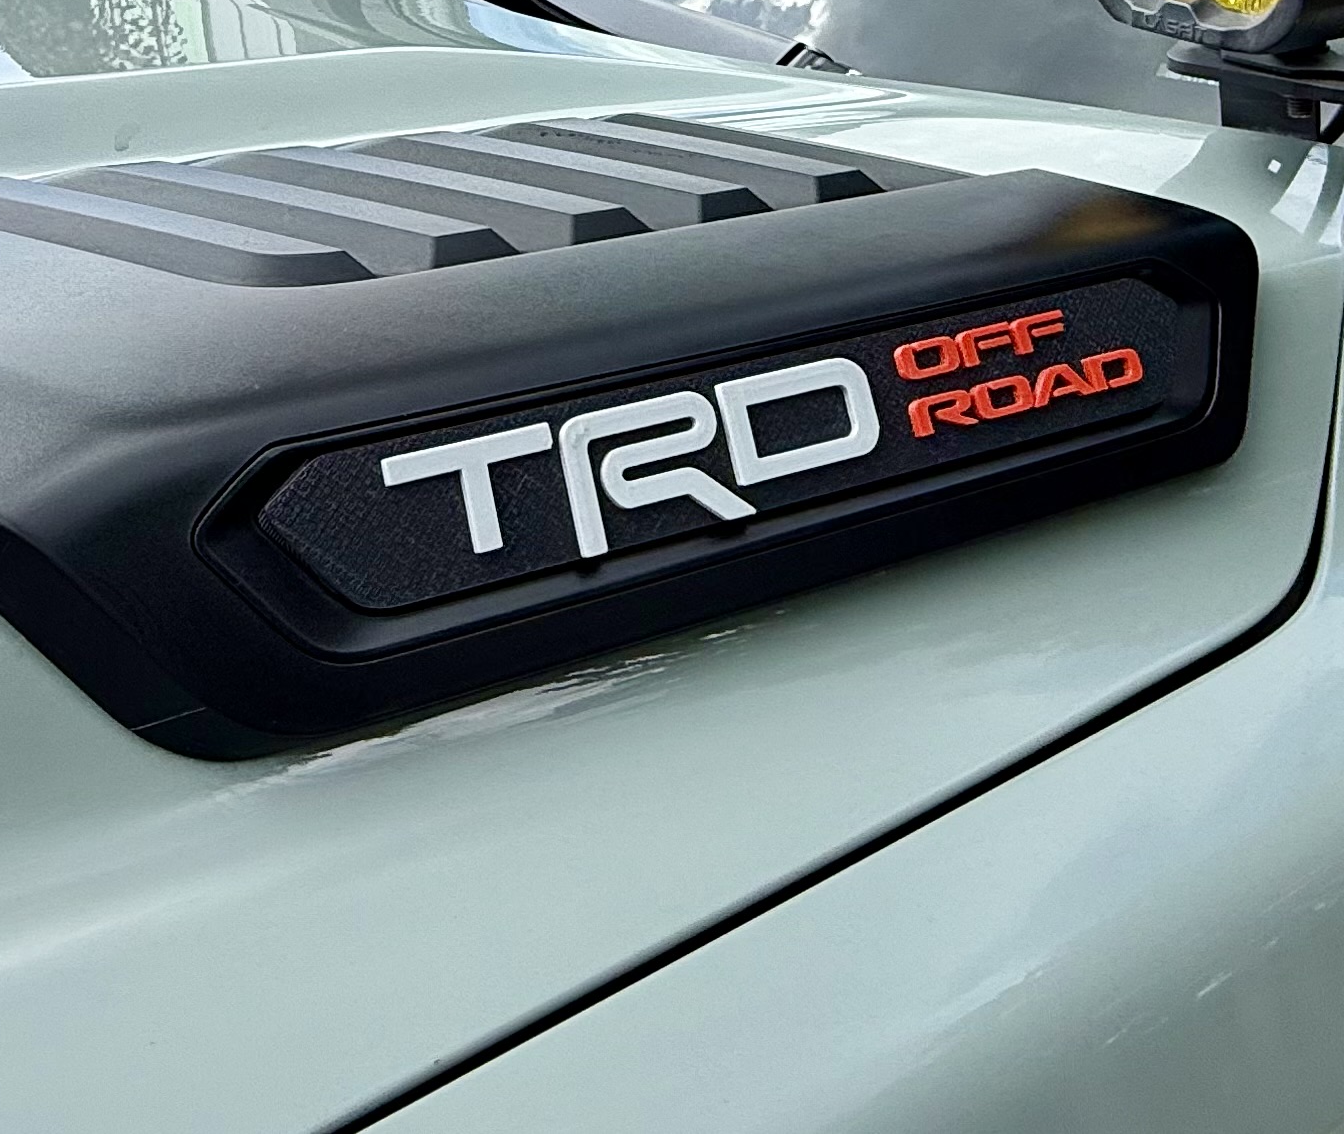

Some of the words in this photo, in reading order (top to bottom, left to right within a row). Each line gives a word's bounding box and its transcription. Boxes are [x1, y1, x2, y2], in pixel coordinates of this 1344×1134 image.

[892, 309, 1066, 381] OFF
[908, 347, 1144, 438] ROAD
[381, 357, 880, 558] TRD
